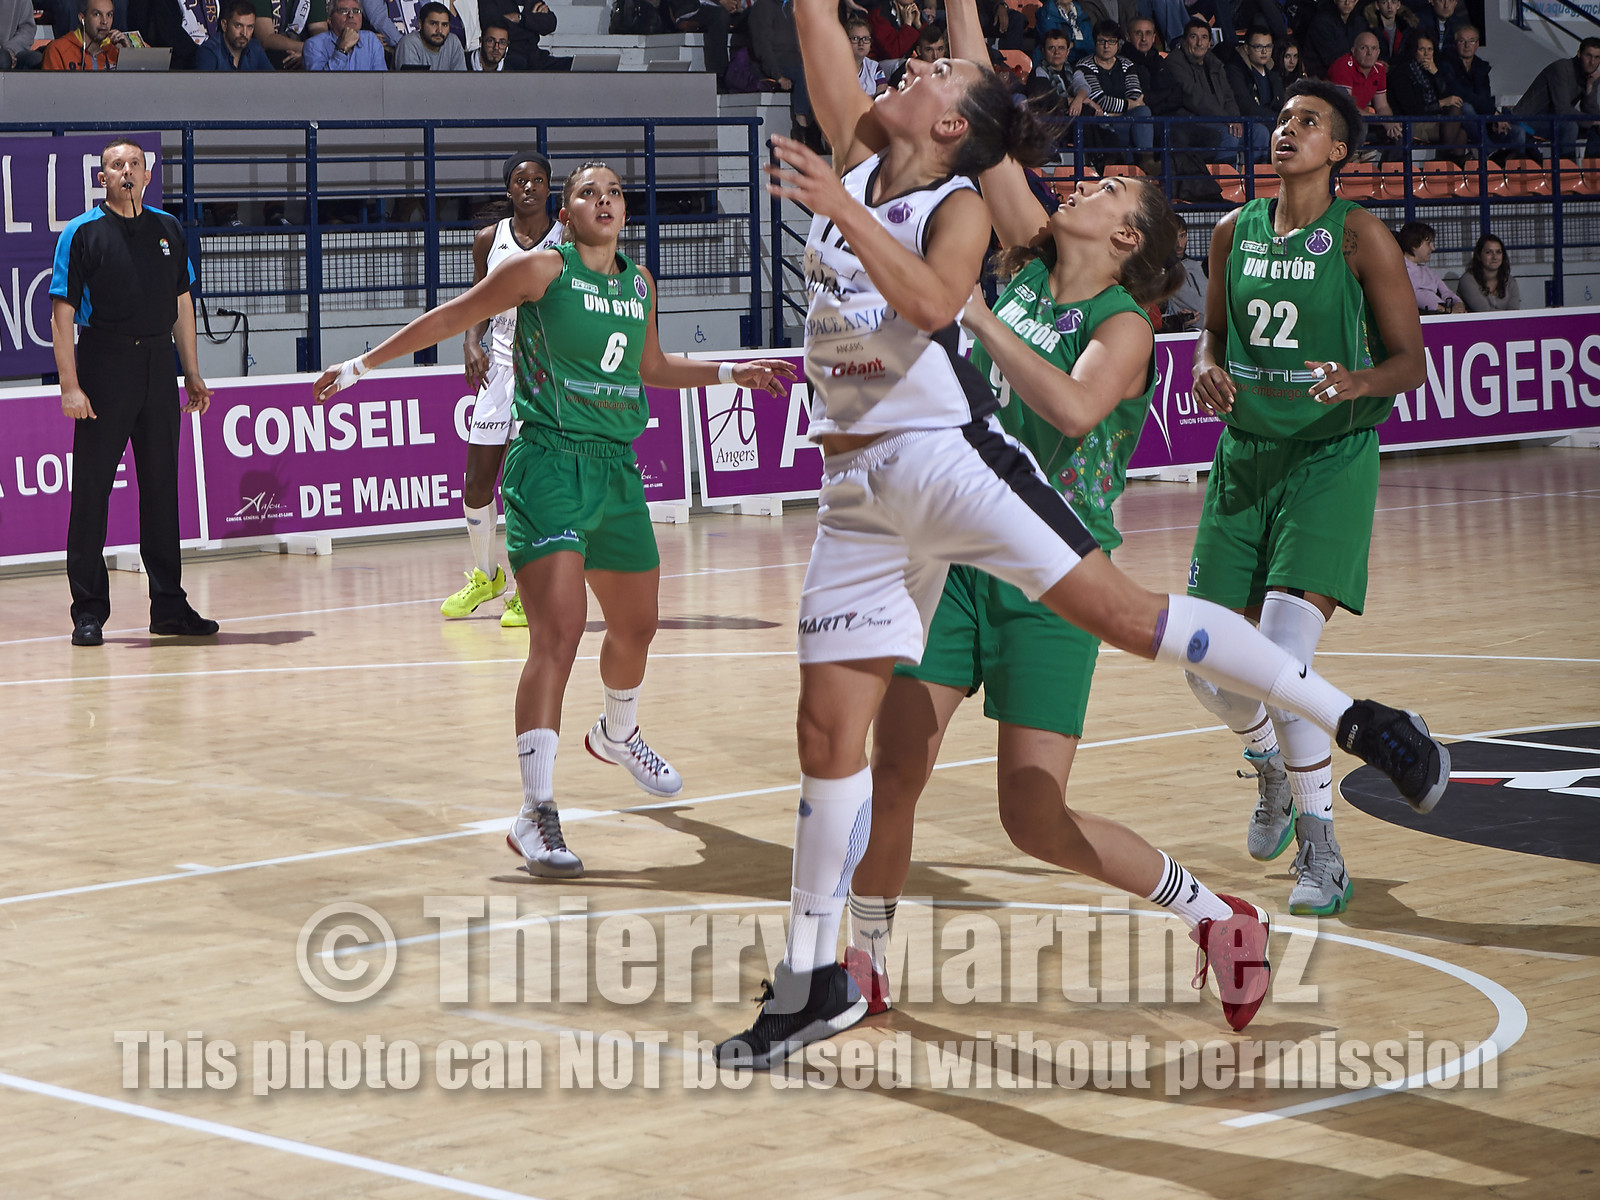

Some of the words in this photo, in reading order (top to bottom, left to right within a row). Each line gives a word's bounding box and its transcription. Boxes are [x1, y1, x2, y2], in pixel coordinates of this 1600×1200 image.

[1243, 257, 1269, 279] UNI
[583, 293, 610, 315] UNI
[1247, 298, 1299, 349] 22
[600, 331, 628, 373] 6
[831, 356, 886, 378] Géant
[222, 398, 436, 458] CONSEIL
[715, 448, 755, 468] Angers
[299, 482, 343, 519] DE
[798, 611, 858, 635] MARTY
